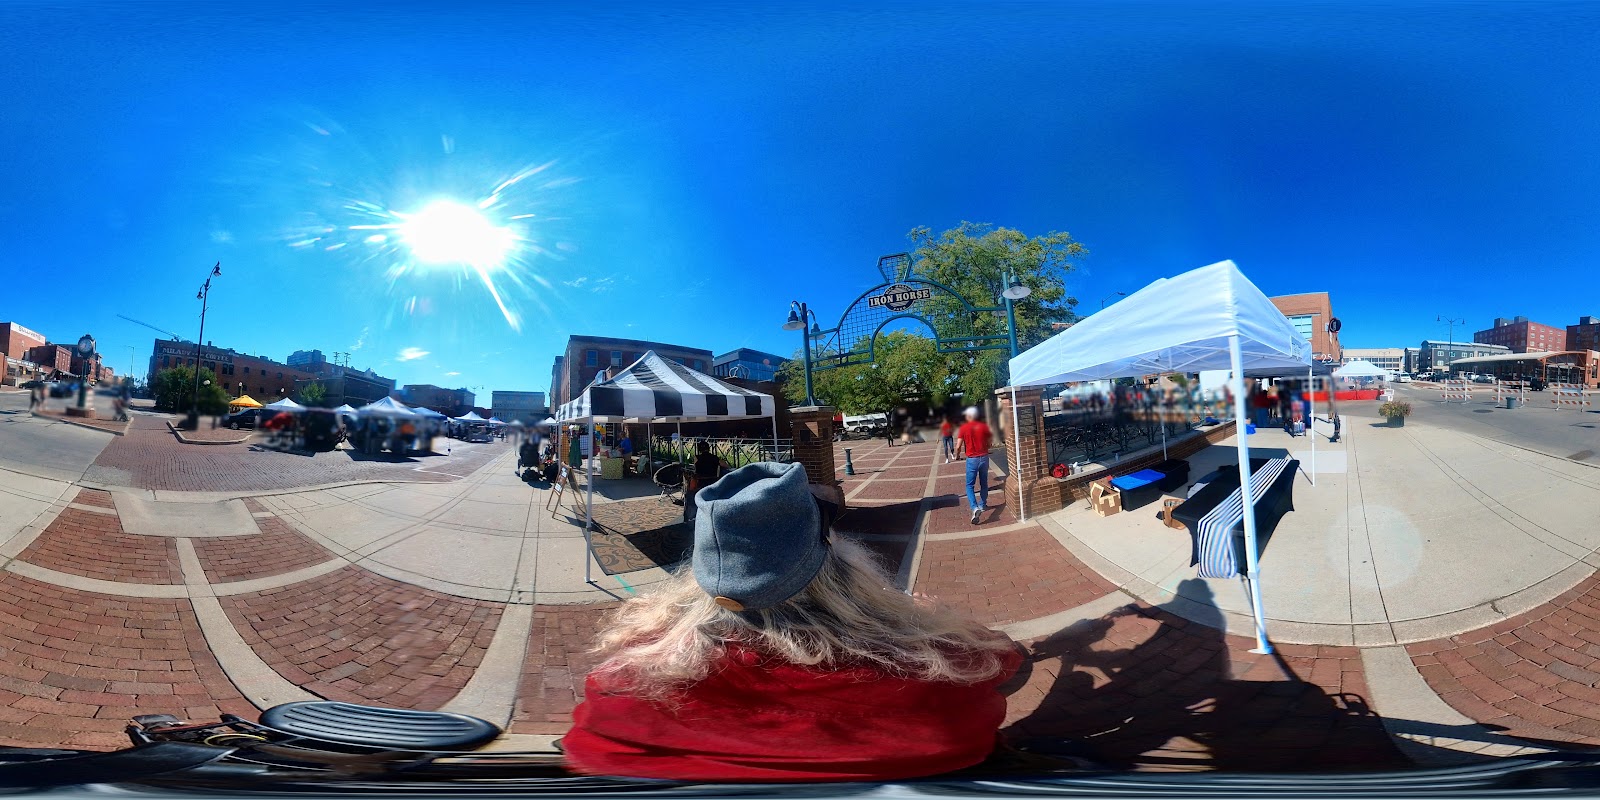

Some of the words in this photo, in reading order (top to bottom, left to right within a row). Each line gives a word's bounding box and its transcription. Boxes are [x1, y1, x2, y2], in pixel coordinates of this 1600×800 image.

[870, 295, 894, 306] IRON
[896, 290, 929, 302] HORSE
[163, 347, 191, 356] MILADY
[1321, 353, 1333, 363] 25
